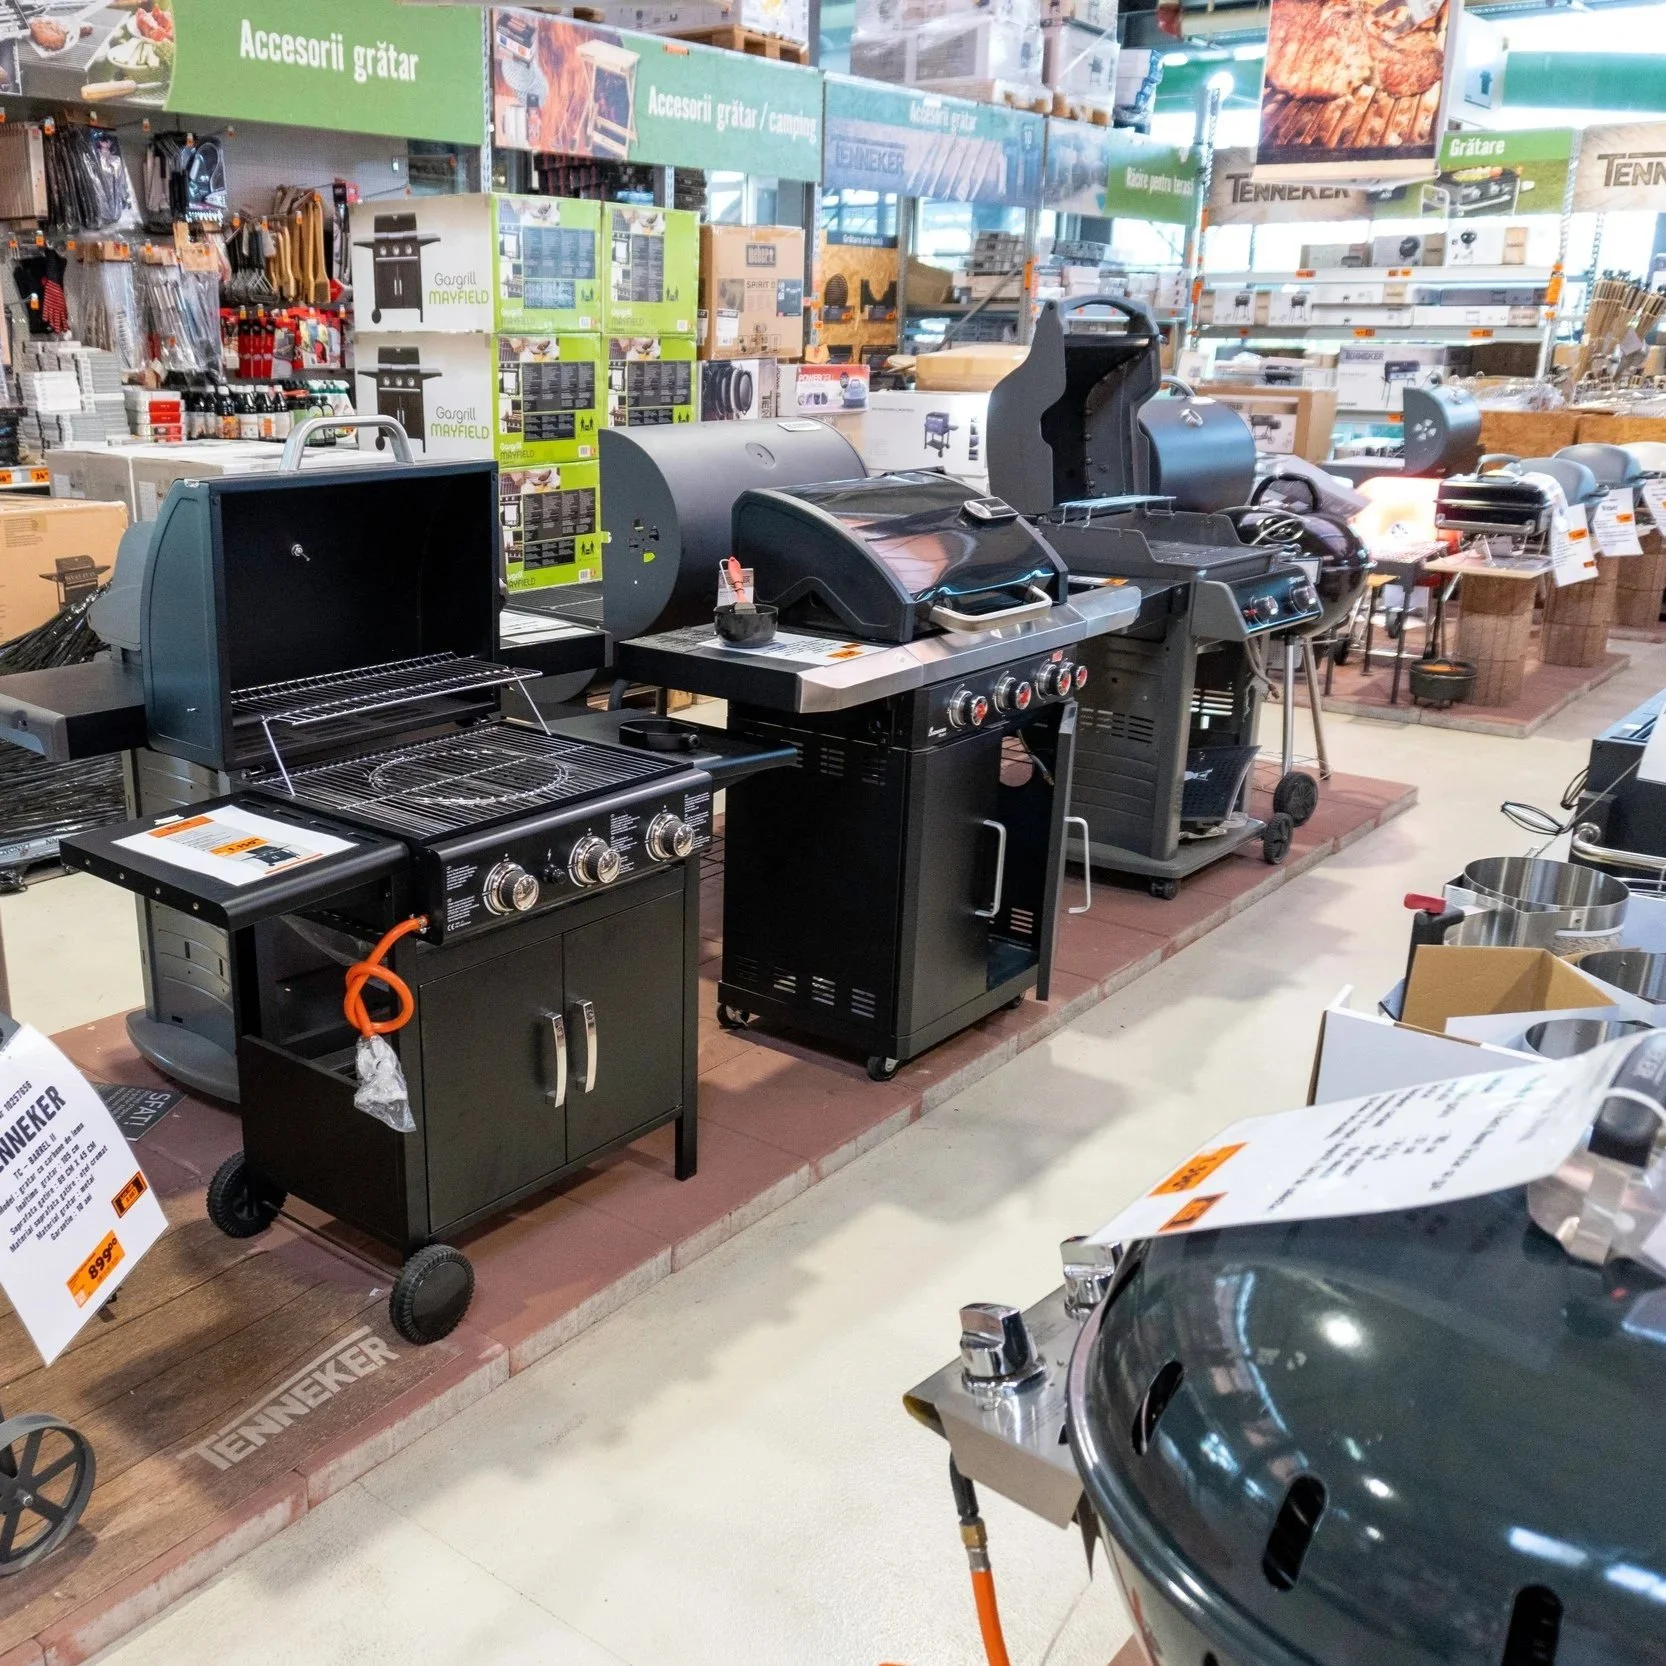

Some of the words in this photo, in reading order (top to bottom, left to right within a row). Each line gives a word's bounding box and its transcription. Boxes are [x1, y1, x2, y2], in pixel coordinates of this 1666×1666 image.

[240, 19, 344, 72] Accesorii
[353, 40, 420, 84] grătar
[647, 85, 712, 124] Accesorii
[716, 99, 758, 133] grătar
[759, 101, 769, 131] /
[769, 108, 817, 146] camping
[909, 100, 950, 126] Accesorii
[830, 134, 905, 176] TENNEKER
[1449, 137, 1506, 157] Grătare
[428, 289, 490, 305] MAYFIELD
[434, 271, 477, 290] Gasgrill
[430, 422, 490, 440] MAYFIELD
[435, 405, 476, 424] Gasgrill
[500, 449, 535, 460] MAYFIELD
[3, 1080, 32, 1112] 10257656
[124, 1092, 171, 1126] SFAT!
[12, 1168, 24, 1180] TC
[27, 1140, 51, 1165] BARREL
[37, 1187, 55, 1209] gatire
[64, 1164, 75, 1177] CM
[86, 1140, 97, 1153] CM
[40, 1167, 58, 1189] gratar
[60, 1151, 72, 1165] 105
[18, 1172, 36, 1195] gratar
[9, 1225, 34, 1253] Material
[59, 1180, 76, 1202] gatire
[35, 1212, 60, 1241] Material
[59, 1195, 76, 1217] gratar
[79, 1174, 95, 1193] metal
[50, 1215, 74, 1241] Garantie
[176, 1325, 401, 1472] TENNEKER
